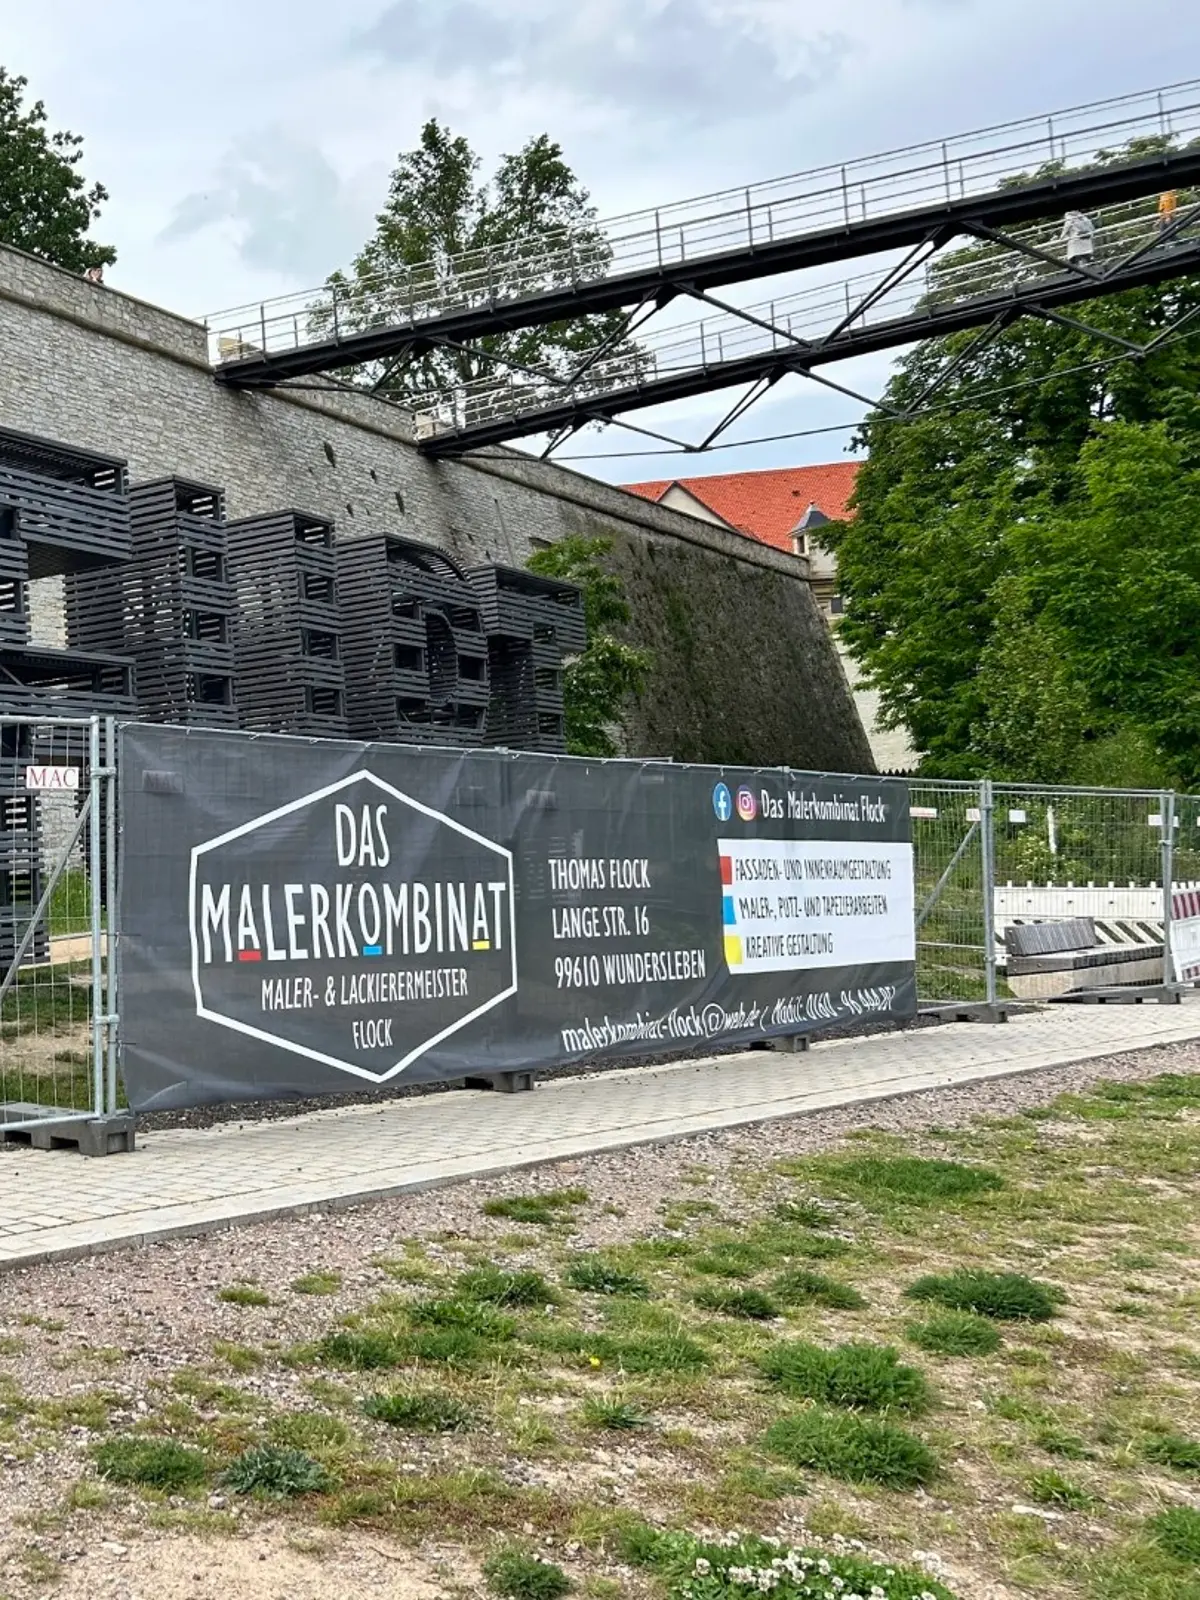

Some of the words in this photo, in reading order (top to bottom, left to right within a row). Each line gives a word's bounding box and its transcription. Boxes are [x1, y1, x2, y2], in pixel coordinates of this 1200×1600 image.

[28, 767, 77, 787] MAC
[760, 789, 784, 819] Das
[787, 790, 860, 822] Malerkombinat
[861, 795, 886, 823] Flock
[334, 803, 391, 868] DAS
[548, 858, 606, 890] THOMAS
[609, 858, 651, 889] FLOCK
[735, 858, 782, 881] FASSADEN-
[783, 858, 802, 880] UND
[201, 881, 506, 964] MALERKOMBINAT
[552, 907, 601, 939] LANGE
[602, 906, 631, 937] STR.
[634, 905, 650, 936] 16
[778, 896, 802, 918] PUTZ-
[803, 896, 821, 918] UND
[745, 935, 785, 959] KREATIVE
[786, 932, 835, 957] GESTALTUNG
[554, 955, 600, 989] 99610
[602, 949, 707, 985] WUNDERSLEBEN
[261, 977, 319, 1011] MALER-
[325, 975, 337, 1007] &
[340, 968, 469, 1005] LACKIERERMEISTER
[352, 1018, 394, 1050] FLOCK
